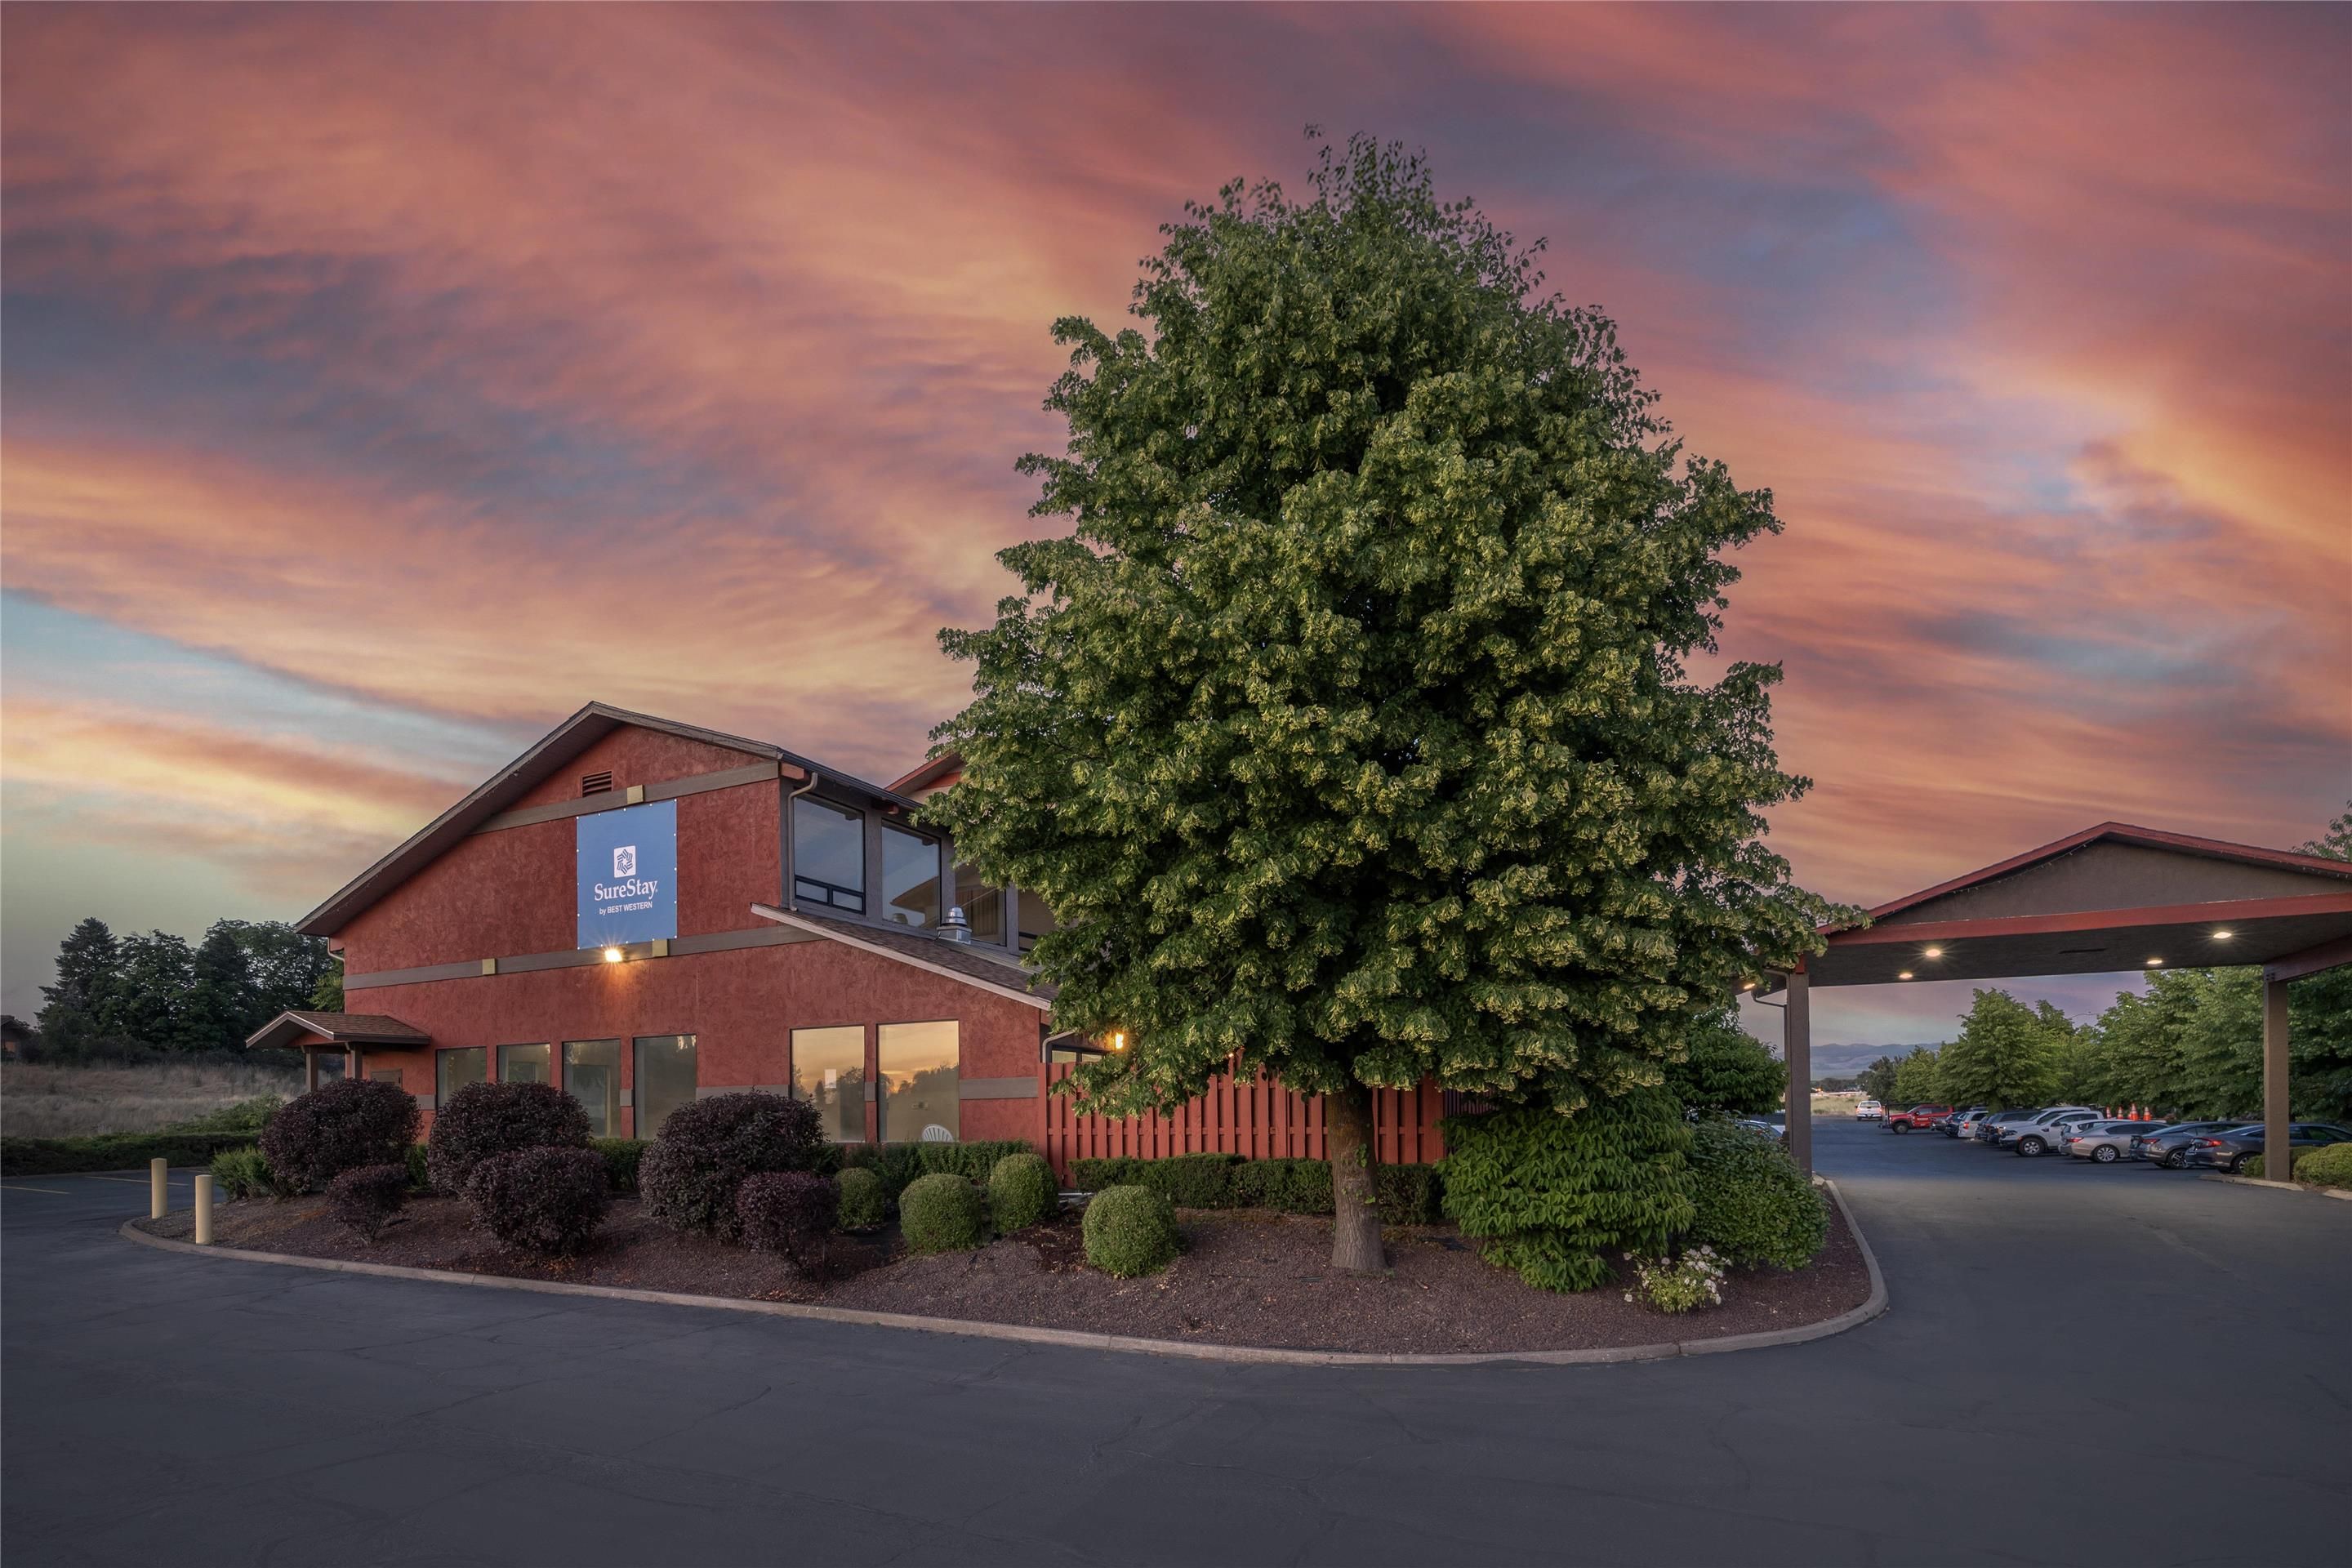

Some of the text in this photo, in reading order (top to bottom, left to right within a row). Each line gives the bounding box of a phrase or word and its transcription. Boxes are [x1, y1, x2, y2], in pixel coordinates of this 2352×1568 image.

[595, 879, 657, 901] SureStay
[607, 905, 623, 914] BEST
[623, 901, 653, 911] WESTERN
